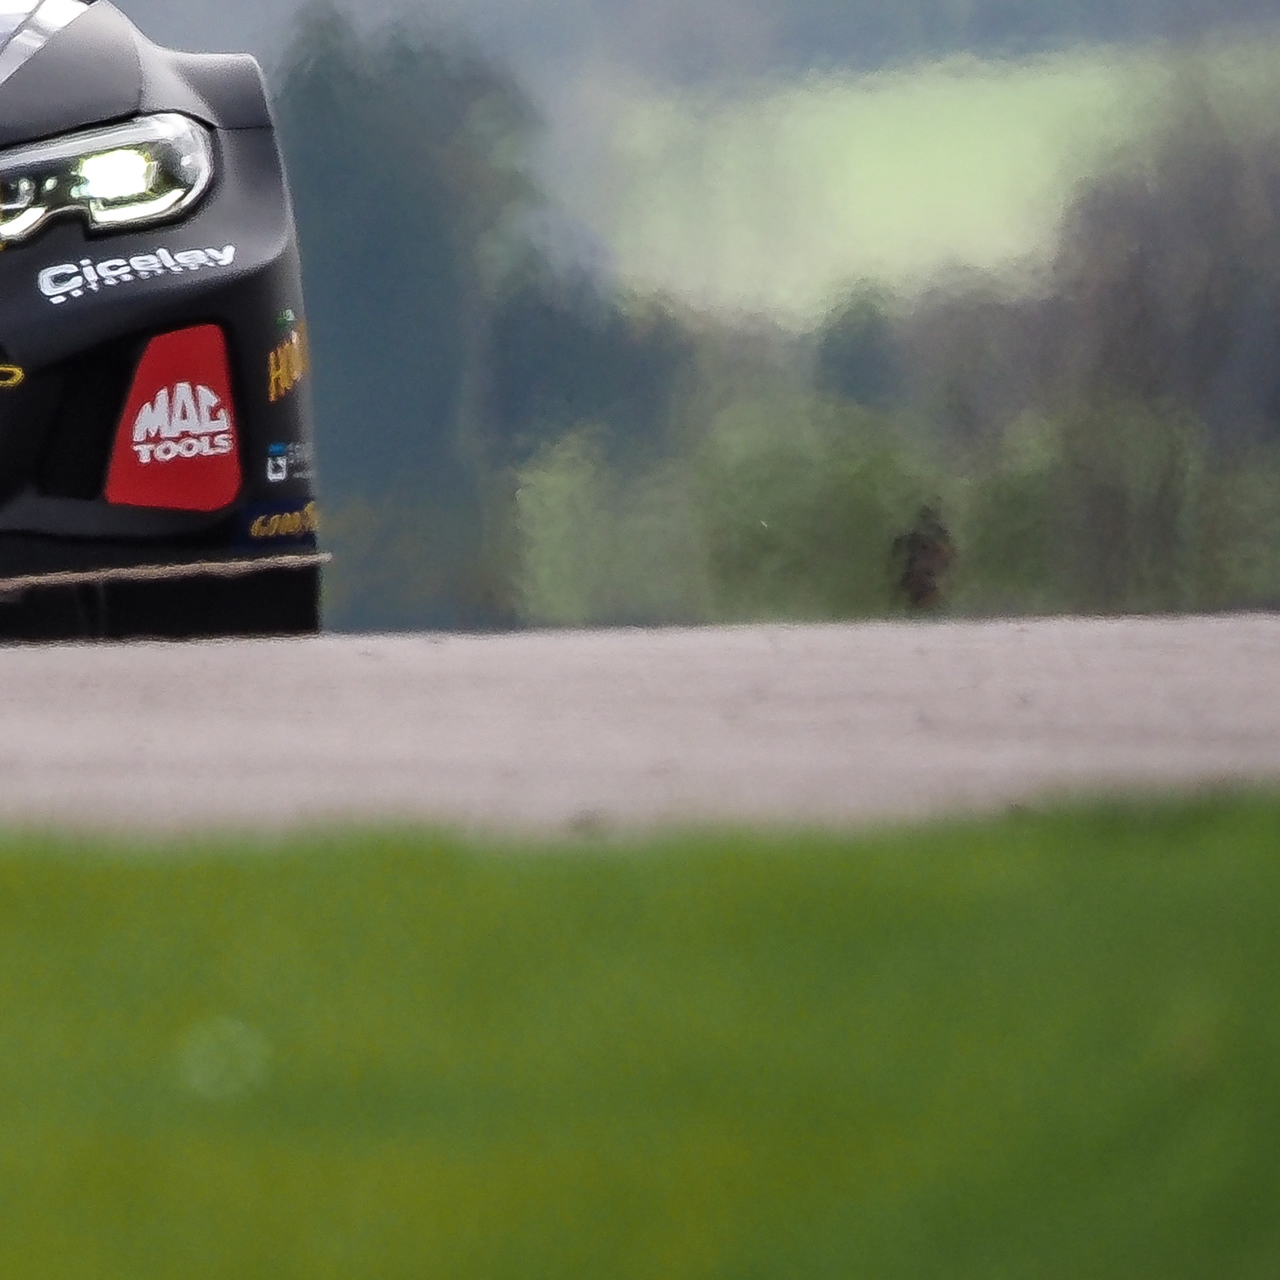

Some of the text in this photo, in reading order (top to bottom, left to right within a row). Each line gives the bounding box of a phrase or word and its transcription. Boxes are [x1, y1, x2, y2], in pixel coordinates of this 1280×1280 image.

[37, 244, 237, 297] Ciceley
[132, 381, 230, 442] MAC
[132, 434, 235, 464] TOOLS
